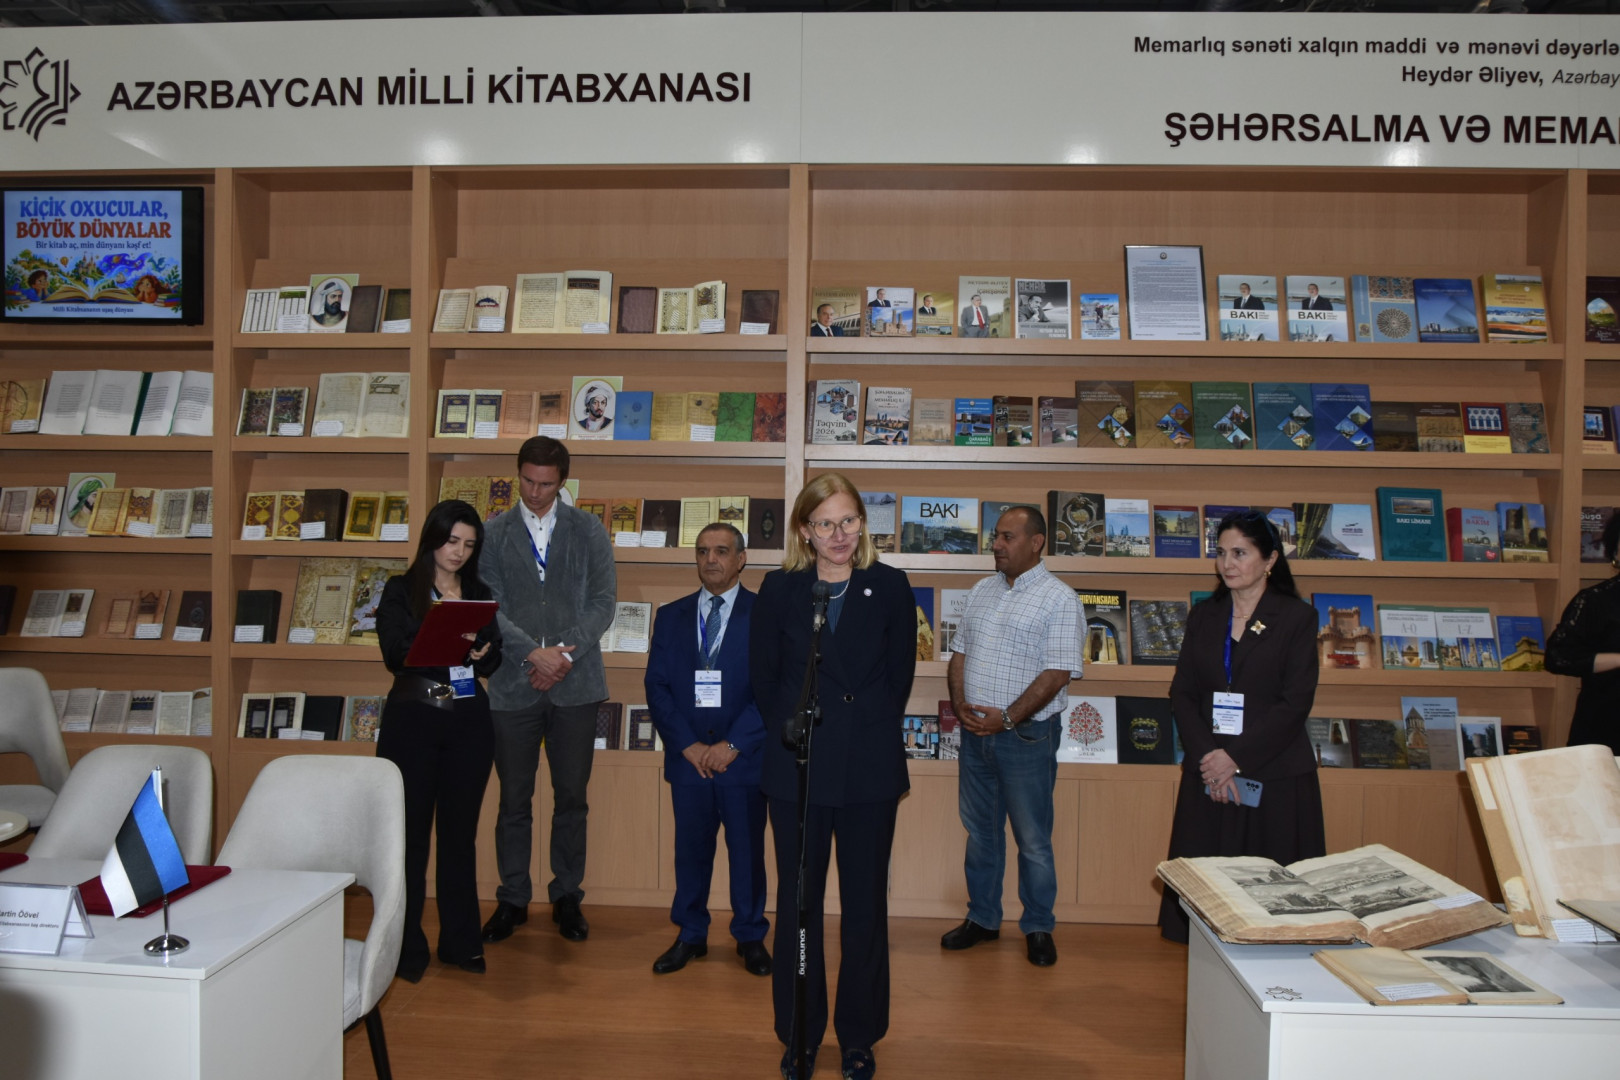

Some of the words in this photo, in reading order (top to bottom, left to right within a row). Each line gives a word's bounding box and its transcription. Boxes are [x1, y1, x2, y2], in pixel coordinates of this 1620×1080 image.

[1134, 36, 1225, 57] Memarlıq
[1231, 36, 1292, 53] sənəti
[1298, 36, 1359, 57] xalqın
[1365, 37, 1427, 54] maddi
[1436, 41, 1460, 55] və
[1468, 38, 1540, 56] mənəvi
[1545, 38, 1620, 60] dəyərlə
[1402, 65, 1474, 87] Heydər
[1478, 66, 1544, 88] Əliyev,
[106, 76, 363, 111] AZƏRBAYCAN
[377, 66, 474, 106] MİLLİ
[488, 66, 751, 104] KİTABXANASI
[1164, 111, 1430, 148] ŞƏHƏRSALMA
[1439, 114, 1491, 144] VƏ
[1503, 115, 1620, 145] MEMA
[20, 196, 67, 220] KİÇİK
[70, 200, 169, 220] OXUCULAR,
[16, 218, 75, 239] BÖYÜK
[79, 218, 172, 239] DÜNYALAR
[35, 241, 47, 249] Bir
[49, 241, 68, 249] kitab
[80, 241, 95, 249] min
[1230, 310, 1259, 320] BAKI
[1297, 311, 1326, 320] BAKI
[815, 420, 847, 428] Təqvim
[920, 502, 959, 519] BAKI
[0, 910, 17, 918] artin
[798, 928, 806, 975] soundking
